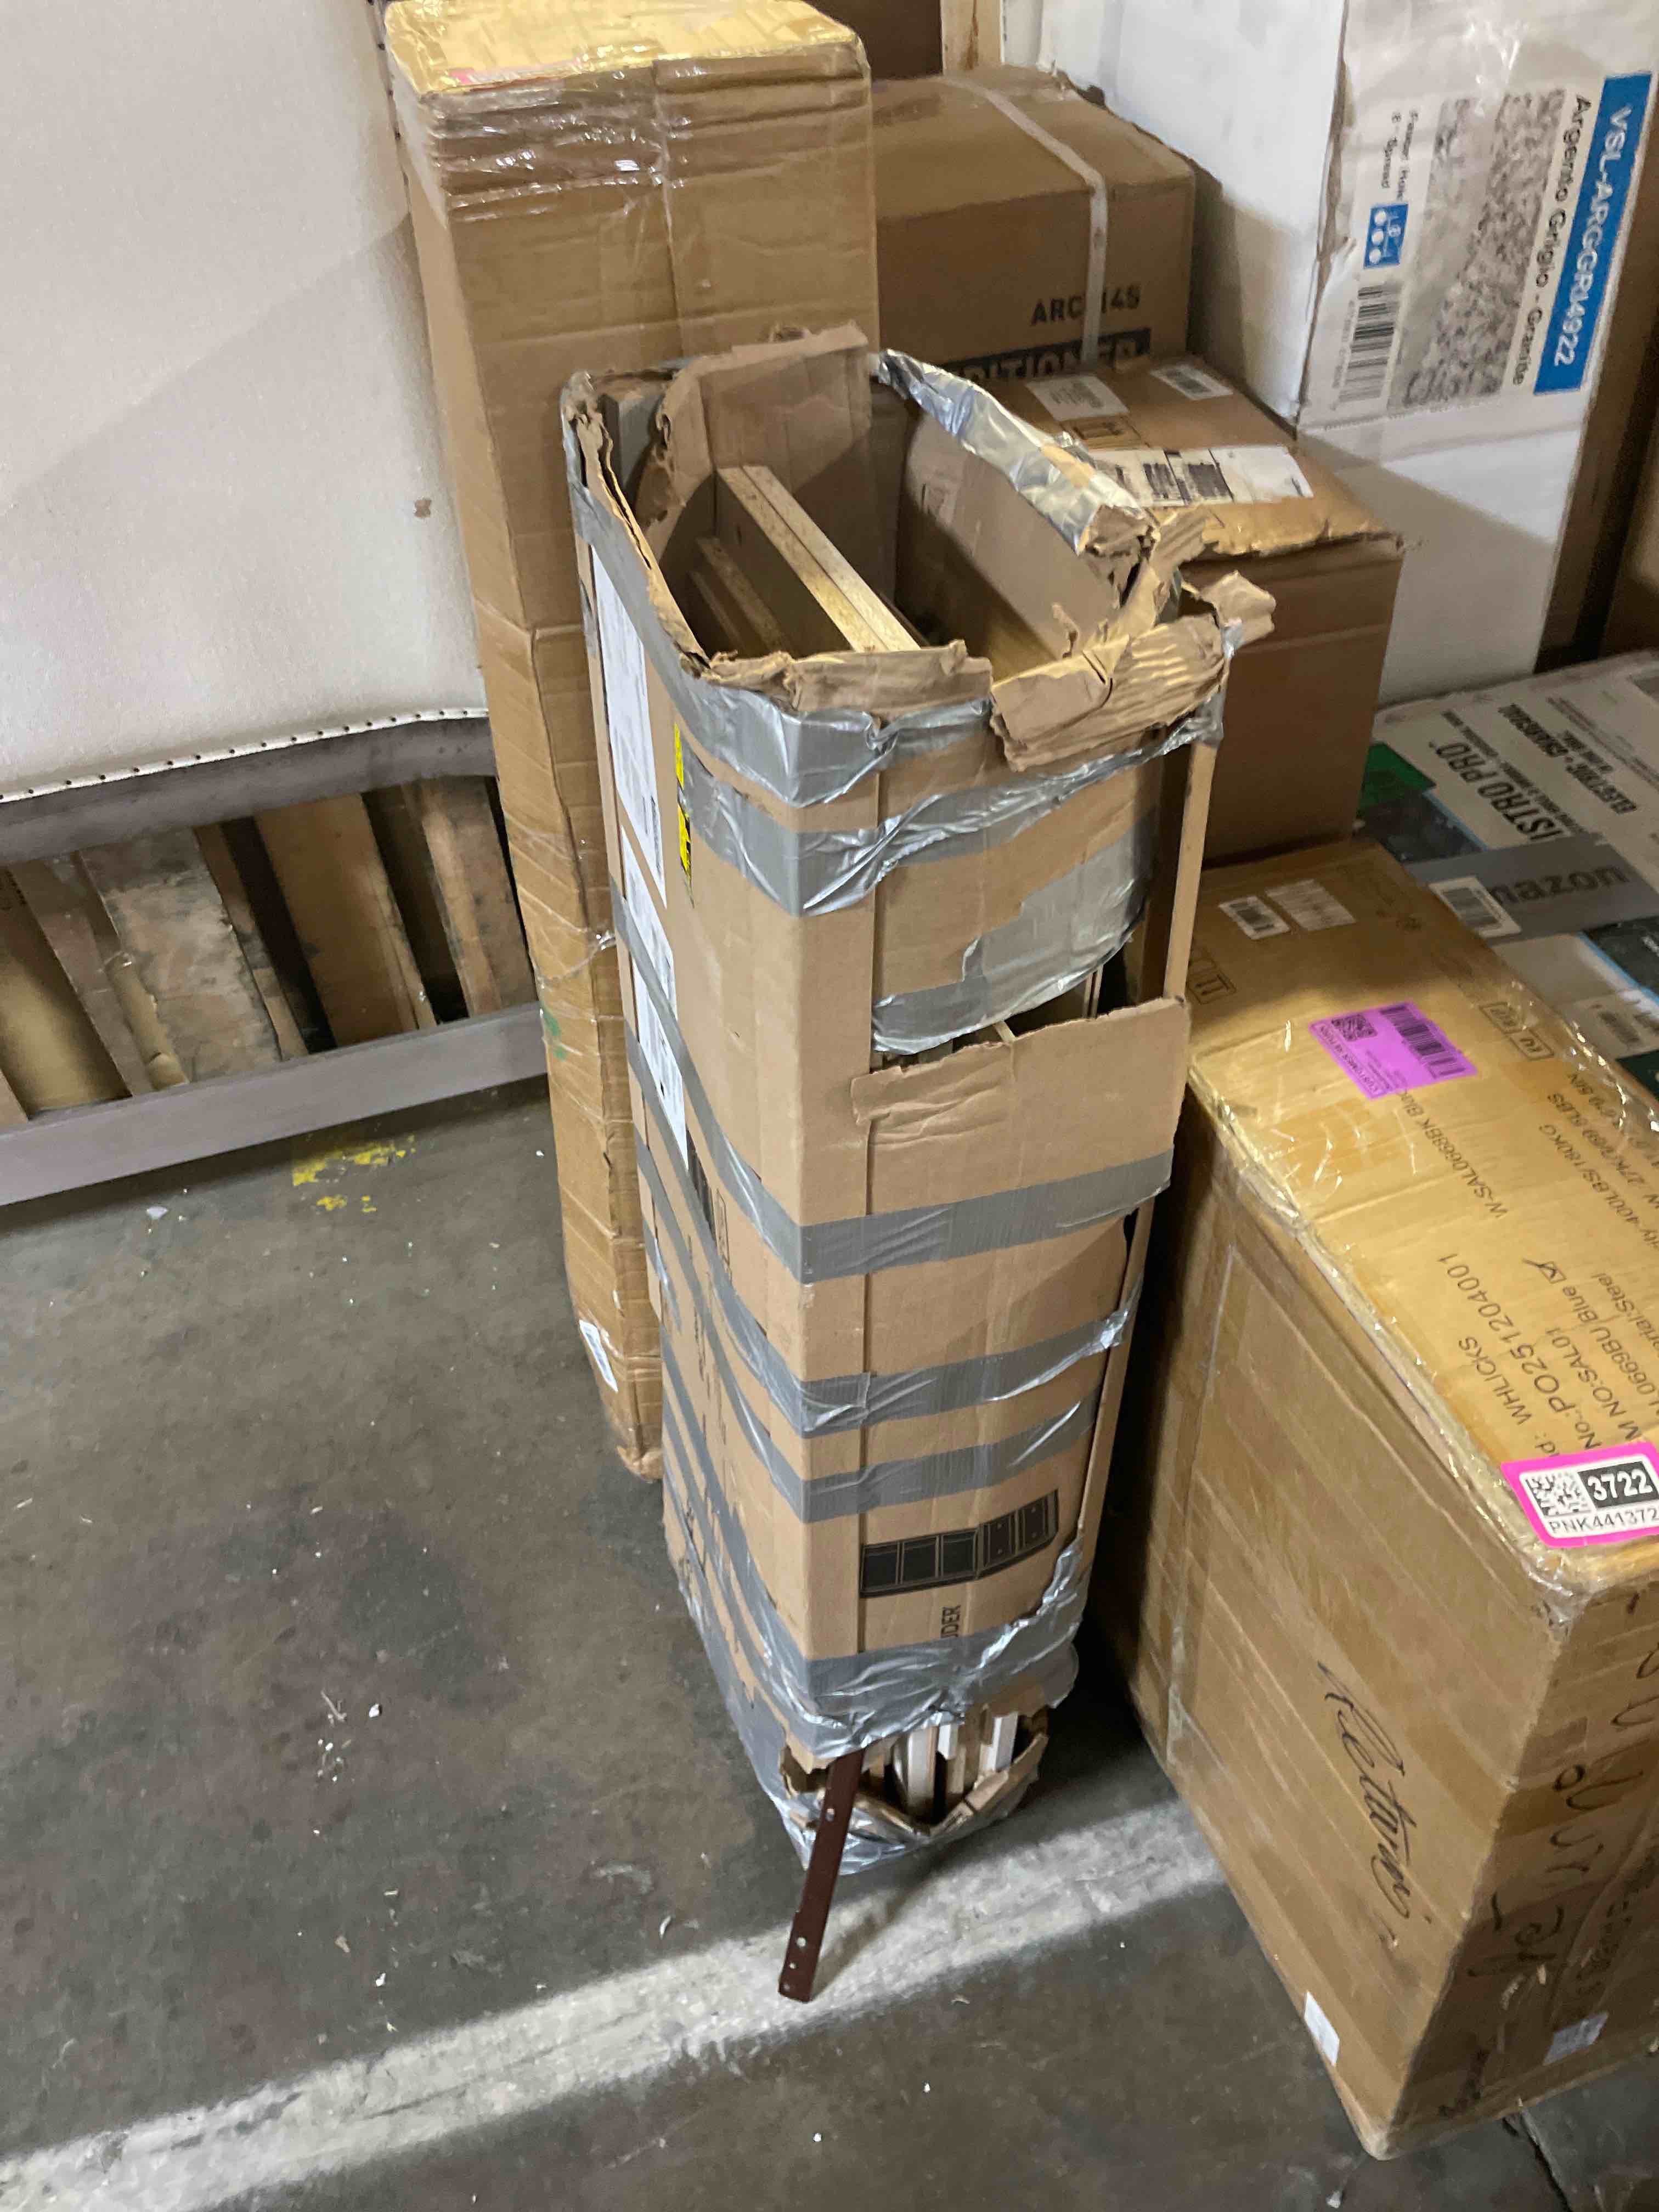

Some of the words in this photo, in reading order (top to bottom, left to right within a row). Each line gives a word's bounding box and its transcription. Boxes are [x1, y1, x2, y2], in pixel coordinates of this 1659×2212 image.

[1555, 97, 1592, 202] Argento
[1537, 208, 1567, 287] Grigio
[1513, 307, 1543, 385] Granite
[1562, 1285, 1598, 1323] Blue
[1458, 1336, 1533, 1426] WHLICKS
[1587, 1468, 1653, 1502] 3722
